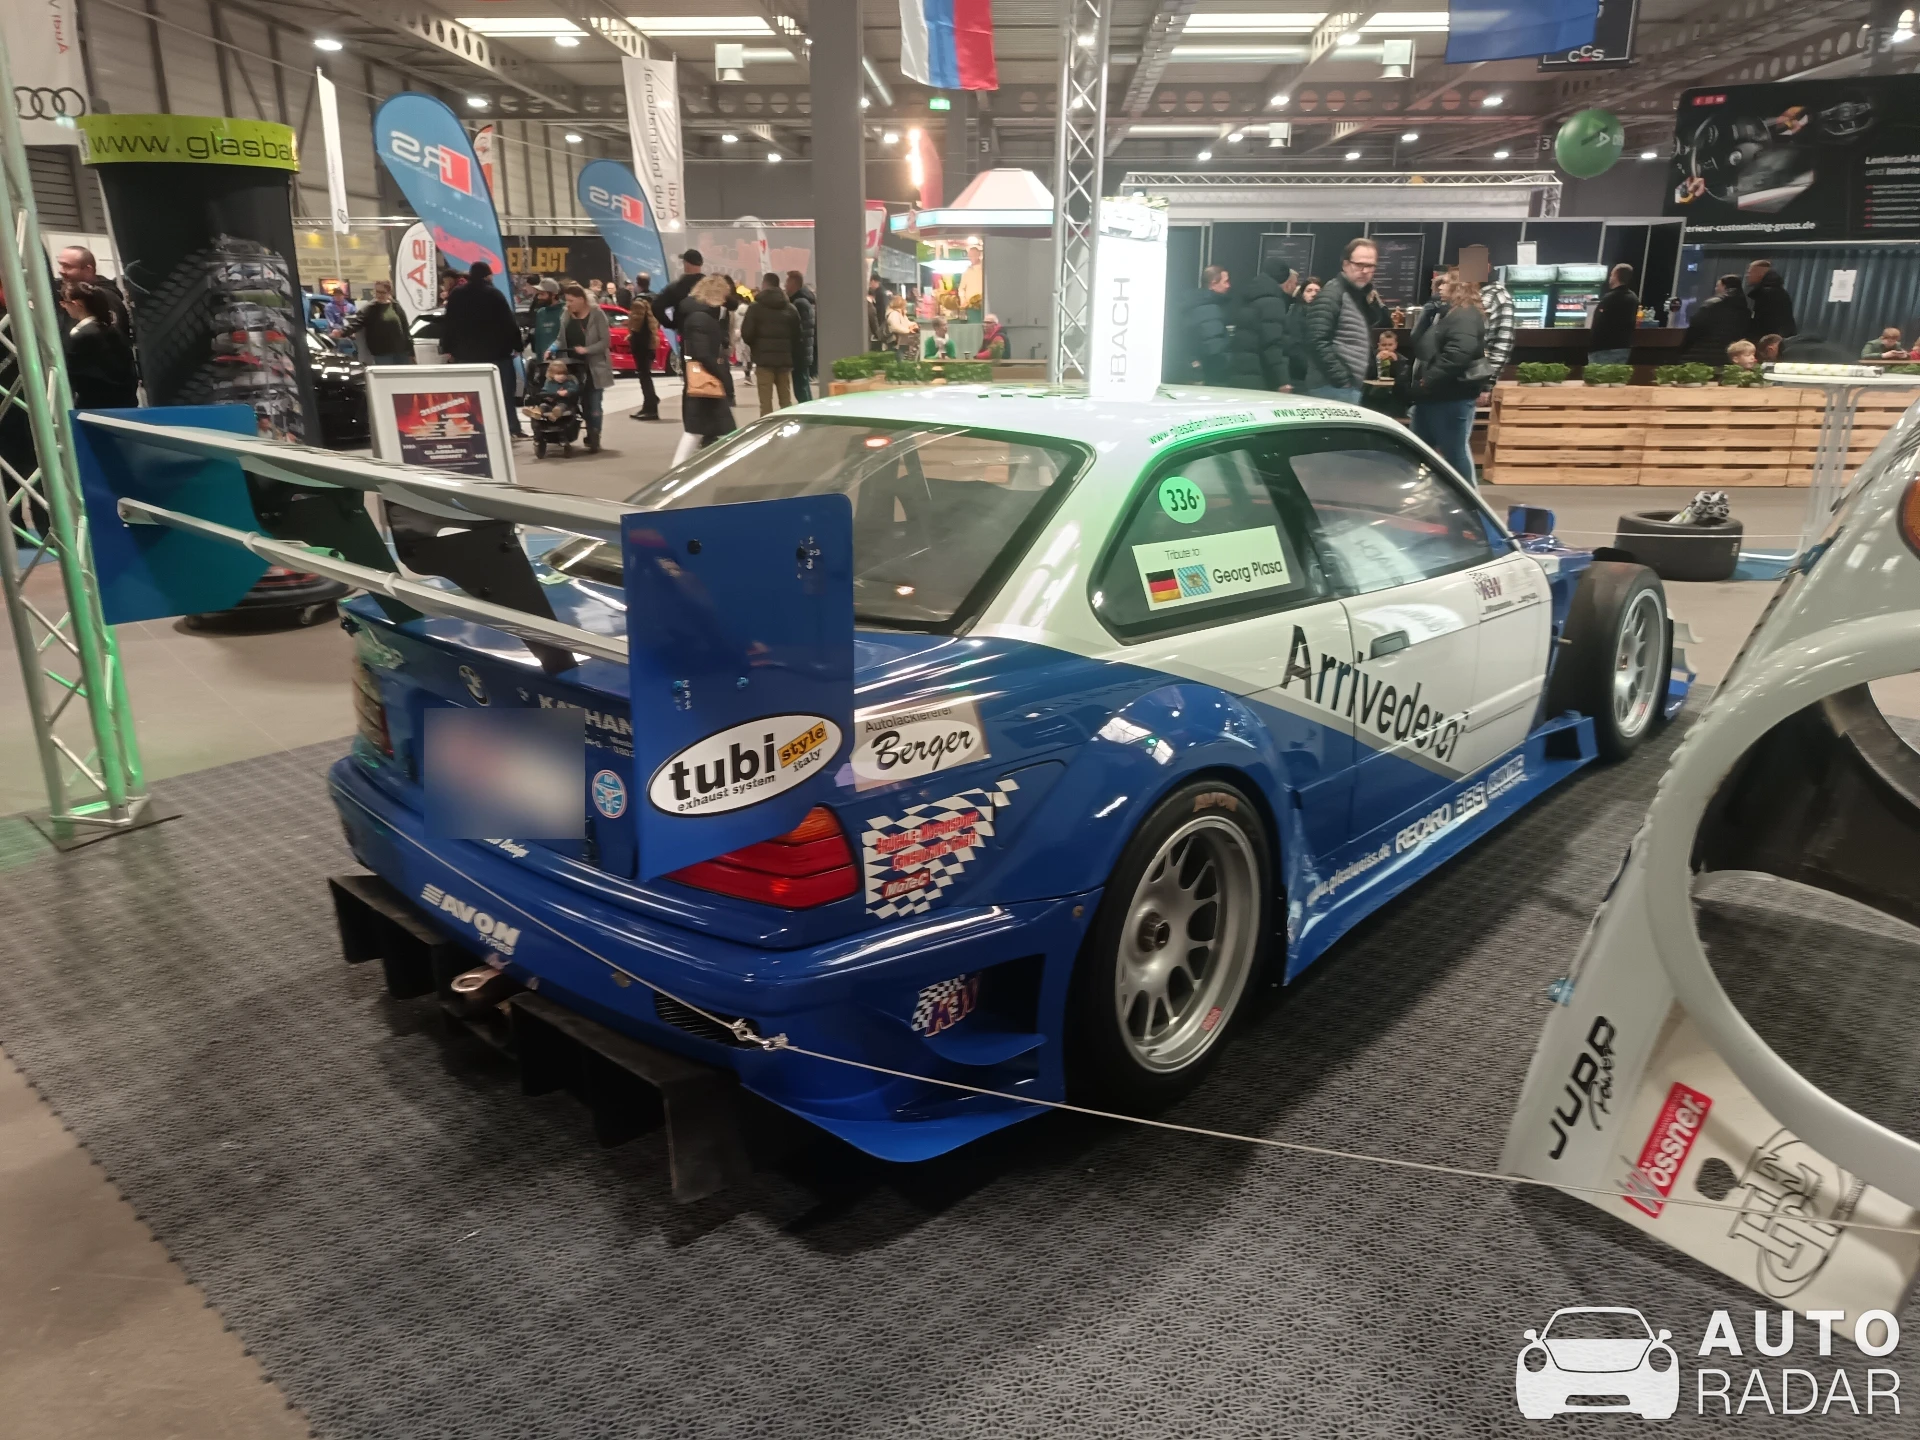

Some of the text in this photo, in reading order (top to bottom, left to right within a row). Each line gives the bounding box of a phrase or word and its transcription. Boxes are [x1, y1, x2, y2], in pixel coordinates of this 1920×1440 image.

[1568, 45, 1605, 62] CCS
[407, 240, 427, 289] A2
[1273, 406, 1362, 420] www.georg-plasa.de
[1166, 488, 1198, 512] 336
[1165, 548, 1200, 560] Tribute to
[1212, 560, 1283, 583] Georg Plasa
[1279, 624, 1470, 763] Arrivederci
[781, 726, 826, 761] style
[793, 747, 822, 773] italy
[871, 730, 974, 771] Berger
[668, 733, 776, 801] tubi
[677, 774, 776, 812] exhaust system
[1395, 803, 1451, 853] RECARO
[440, 894, 522, 947] AVON
[1549, 1016, 1616, 1160] JUDD
